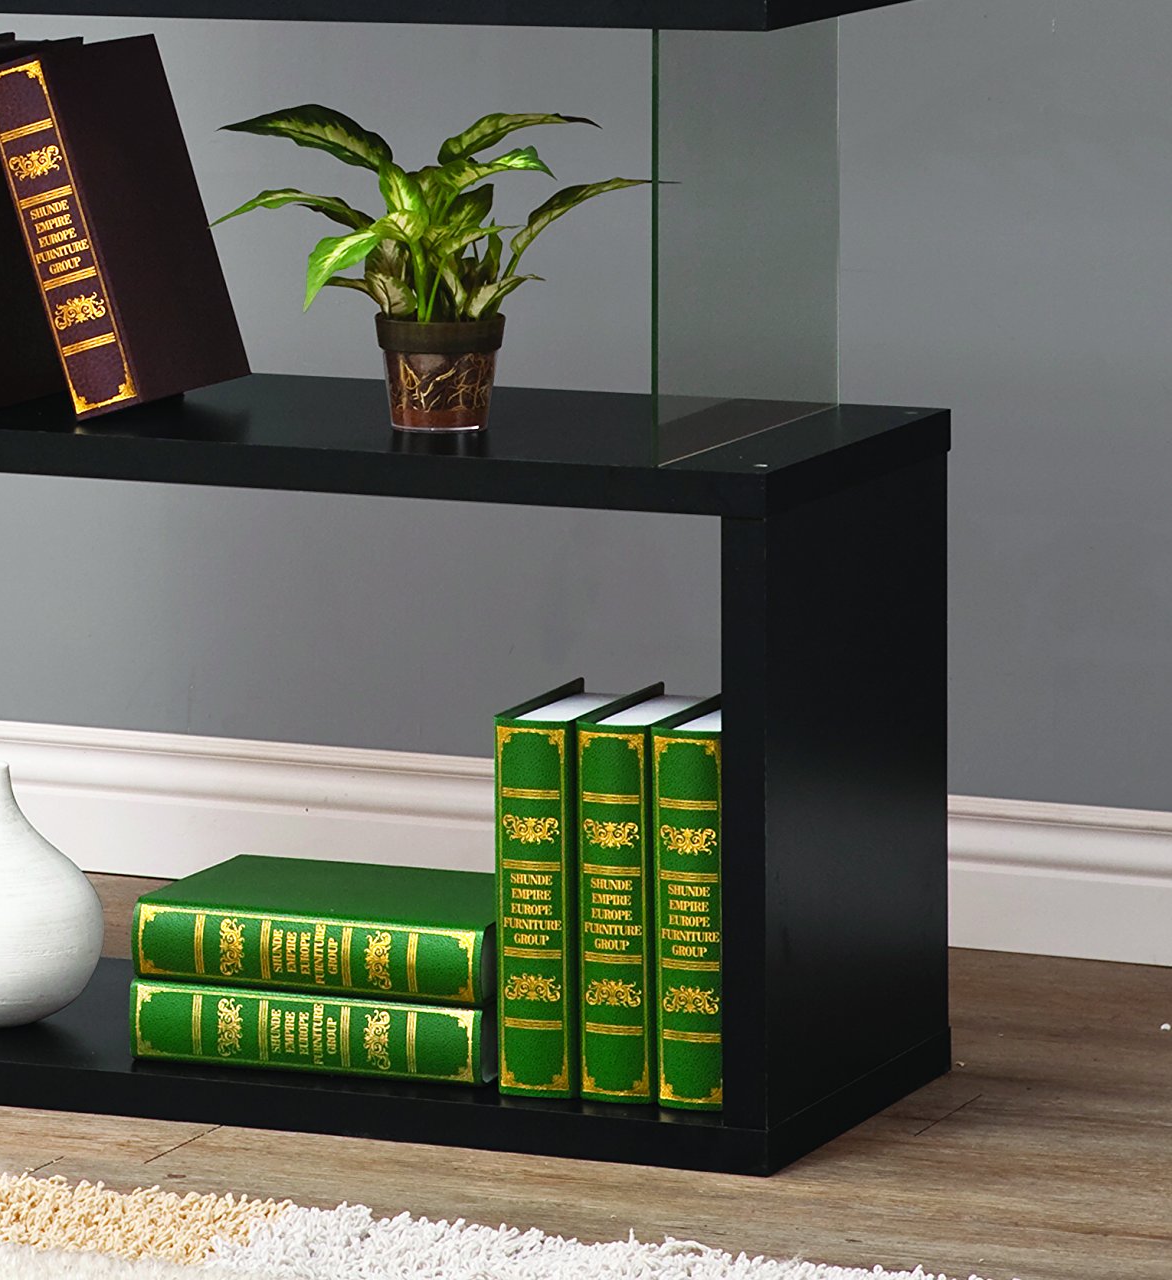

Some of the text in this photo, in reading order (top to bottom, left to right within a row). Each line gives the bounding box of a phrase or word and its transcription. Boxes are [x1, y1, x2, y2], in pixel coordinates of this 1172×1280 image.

[29, 199, 70, 221] SHUNDE
[34, 214, 73, 234] EMPIRE
[38, 227, 78, 249] EUROPE
[35, 238, 90, 265] FURNITURE
[49, 256, 82, 275] GROUP
[510, 872, 553, 886] SHUNDE
[590, 877, 633, 891] SHUNDE
[511, 887, 552, 901] EMPIRE
[591, 893, 632, 906] EMPIRE
[667, 884, 711, 898] SHUNDE
[510, 903, 553, 916] EUROPE
[591, 907, 633, 921] EUROPE
[668, 899, 709, 913] EMPIRE
[503, 917, 562, 931] FURNITURE
[584, 921, 643, 936] FURNITURE
[668, 914, 711, 928] EUROPE
[513, 932, 550, 946] GROUP
[661, 928, 720, 943] FURNITURE
[272, 928, 284, 973] SHUNDE
[286, 931, 297, 973] EMPIRE
[299, 931, 311, 975] EUROPE
[594, 938, 630, 951] GROUP
[671, 945, 708, 958] GROUP
[313, 922, 326, 985] FURNITURE
[327, 937, 338, 975] GROUP
[270, 1008, 282, 1054] SHUNDE
[284, 1011, 295, 1053] EMPIRE
[299, 1011, 309, 1056] EUROPE
[312, 1002, 324, 1065] FURNITURE
[326, 1016, 337, 1055] GROUP
